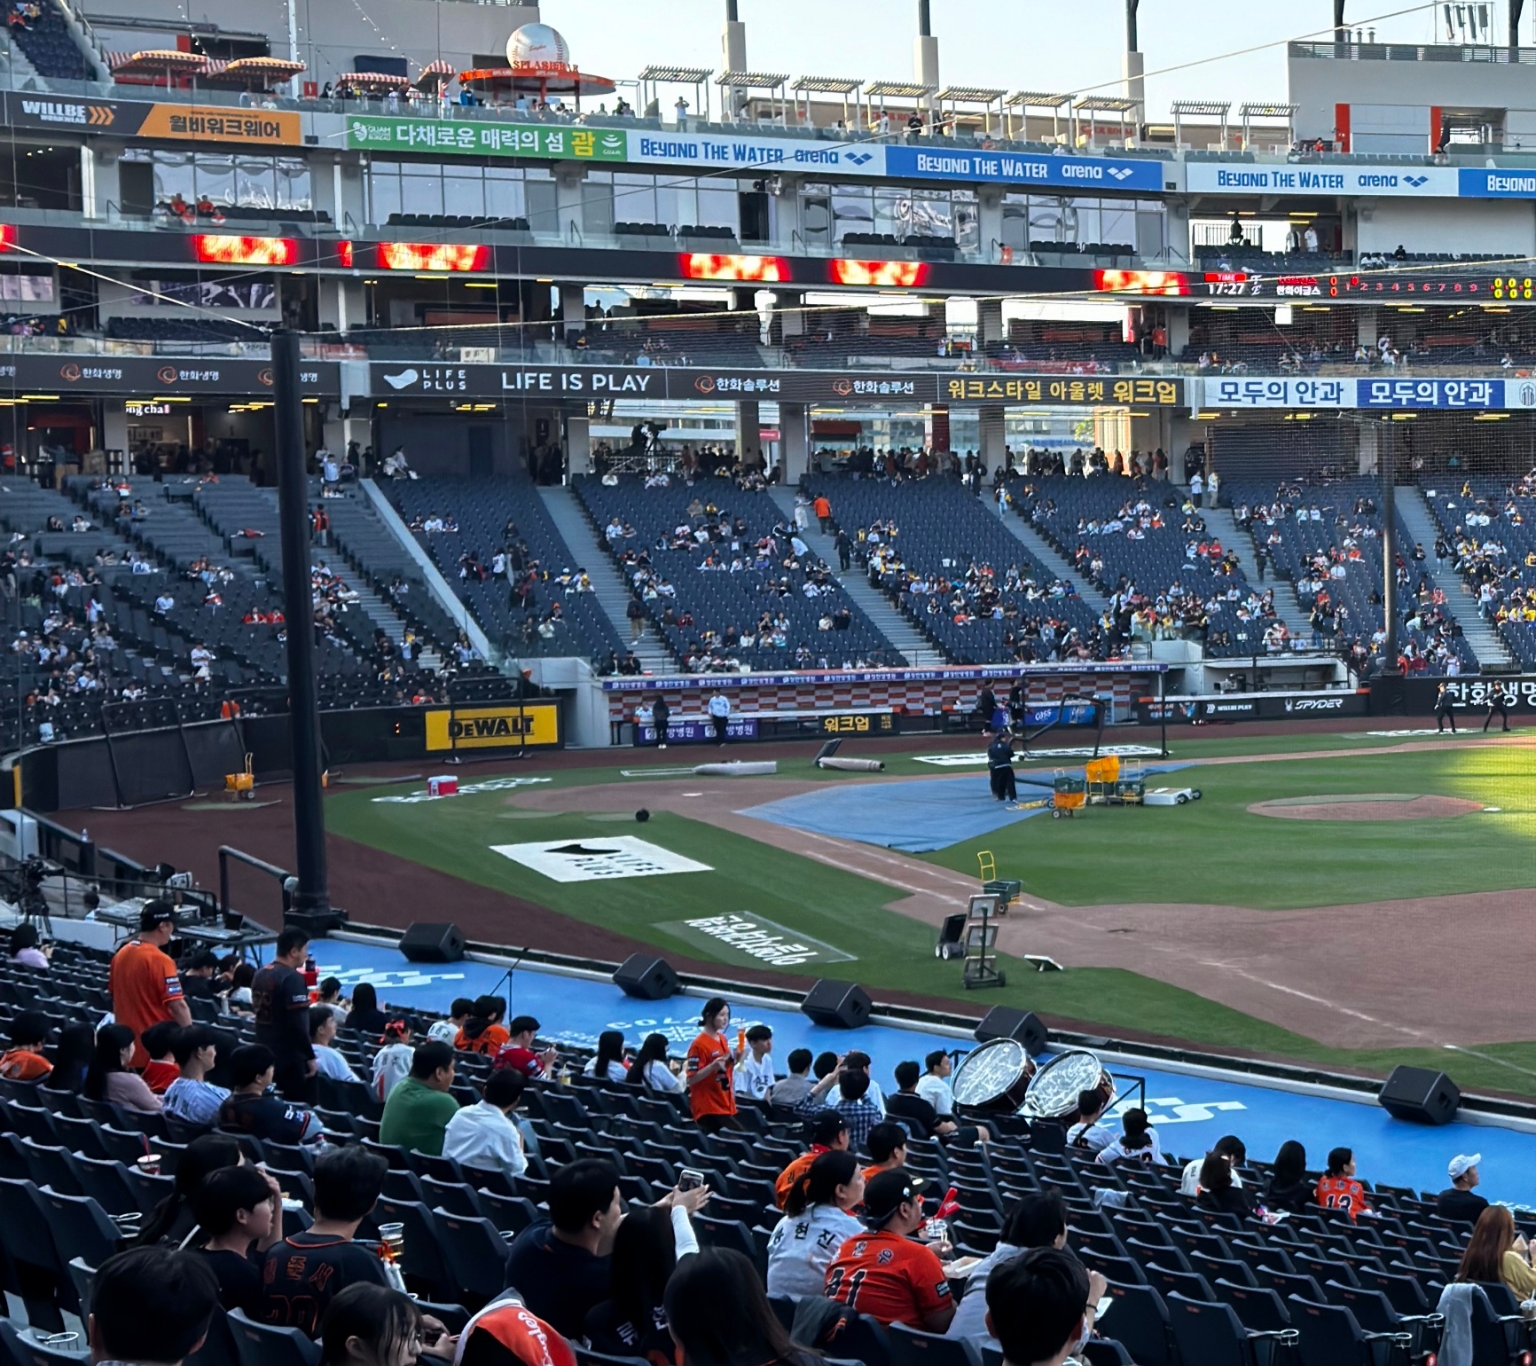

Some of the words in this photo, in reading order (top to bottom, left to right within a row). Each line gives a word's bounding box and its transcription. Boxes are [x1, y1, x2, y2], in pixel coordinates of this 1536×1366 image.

[22, 100, 86, 117] WILLBE
[169, 115, 280, 138] 윌비워크웨어
[396, 124, 476, 149] 다채로운
[481, 128, 539, 152] 매력의
[545, 132, 564, 153] 섬
[571, 131, 595, 156] 괌
[795, 149, 839, 165] arena
[1062, 164, 1102, 180] arena
[1358, 174, 1398, 188] arena
[1208, 282, 1245, 295] 17:27
[82, 367, 122, 380] 한화생명
[179, 369, 219, 382] 한화생명
[423, 369, 467, 380] LIFE
[423, 381, 467, 391] PLUS
[502, 372, 553, 391] LIFE
[562, 373, 583, 391] IS
[592, 373, 651, 393] PLAY
[716, 377, 780, 393] 한화솔루션
[853, 379, 914, 395] 한화솔루션
[948, 379, 1041, 401] 워크스타일
[1050, 380, 1104, 401] 아울렛
[1113, 380, 1177, 404] 워크업
[1218, 381, 1288, 404] 모두의
[1296, 381, 1344, 404] 안과
[1369, 381, 1438, 404] 모두의
[1444, 382, 1493, 405] 안과
[1295, 698, 1343, 710] SPYDER
[824, 715, 869, 732] 워크업
